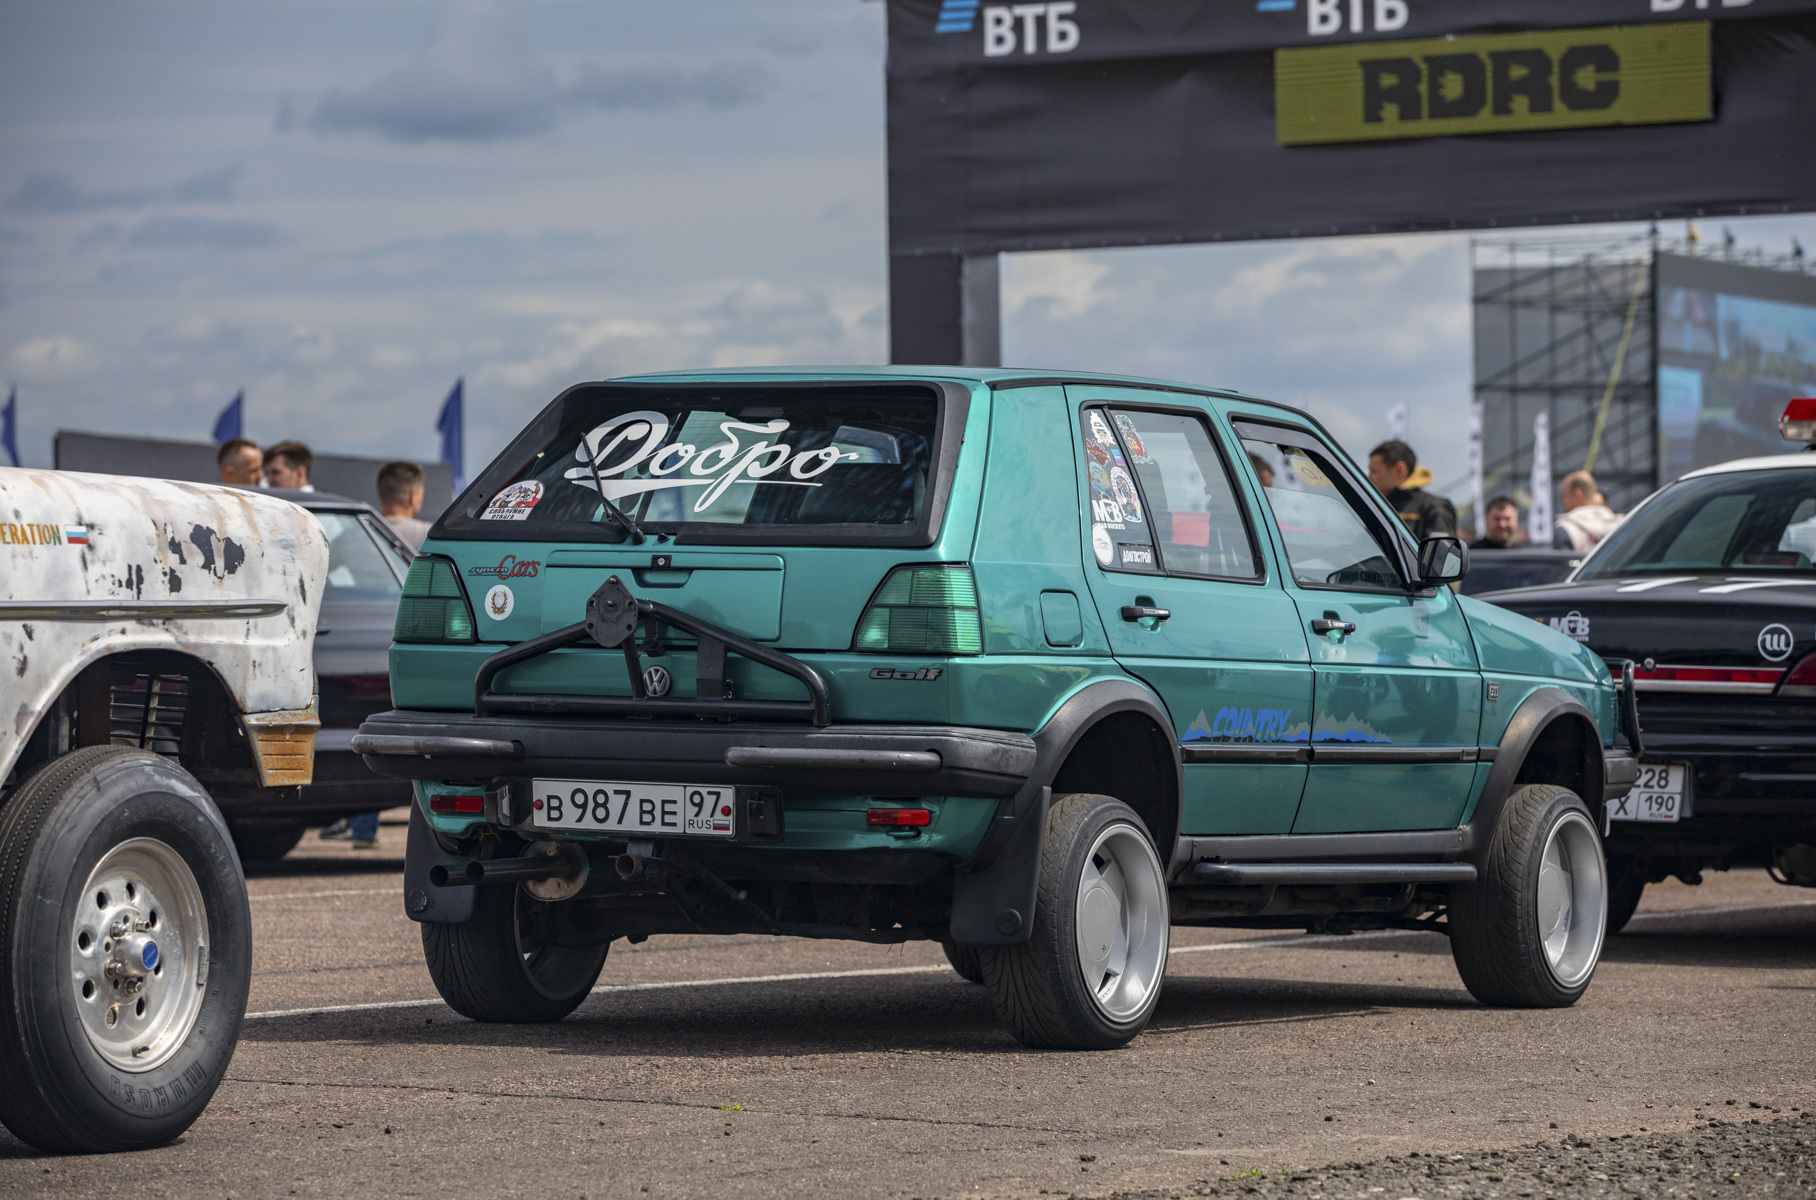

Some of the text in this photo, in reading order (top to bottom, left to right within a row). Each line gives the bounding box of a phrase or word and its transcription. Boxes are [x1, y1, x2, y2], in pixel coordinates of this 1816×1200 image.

[983, 1, 1080, 57] ВТБ
[1359, 44, 1620, 123] RDRC
[563, 410, 860, 513] Добро
[498, 554, 541, 580] Cars
[869, 667, 944, 682] Golf
[1210, 705, 1293, 744] COUNTRY
[689, 790, 721, 818] 97
[1644, 795, 1676, 812] 190
[687, 819, 712, 830] RUS
